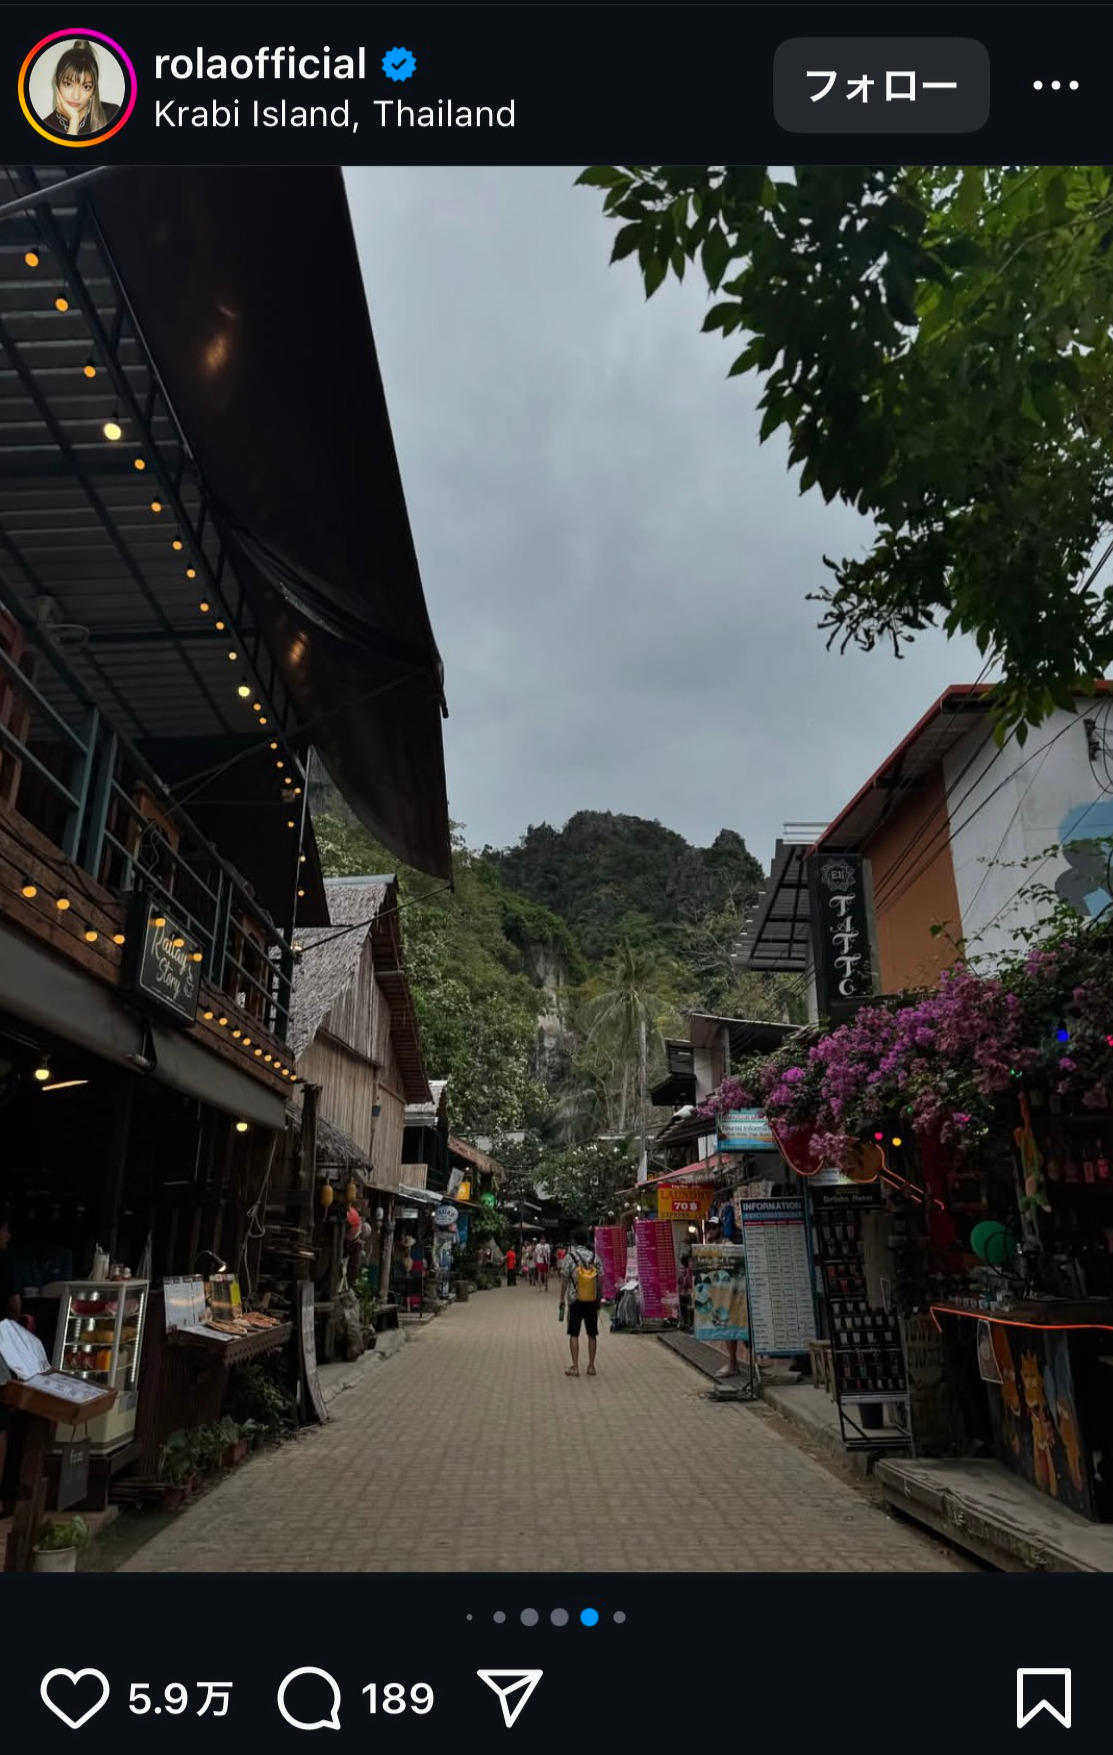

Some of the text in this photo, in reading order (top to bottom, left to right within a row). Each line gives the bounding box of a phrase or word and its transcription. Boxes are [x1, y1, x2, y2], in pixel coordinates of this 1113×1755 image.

[156, 957, 181, 999] Story
[674, 1202, 688, 1210] 70
[742, 1201, 802, 1211] INFORMATION
